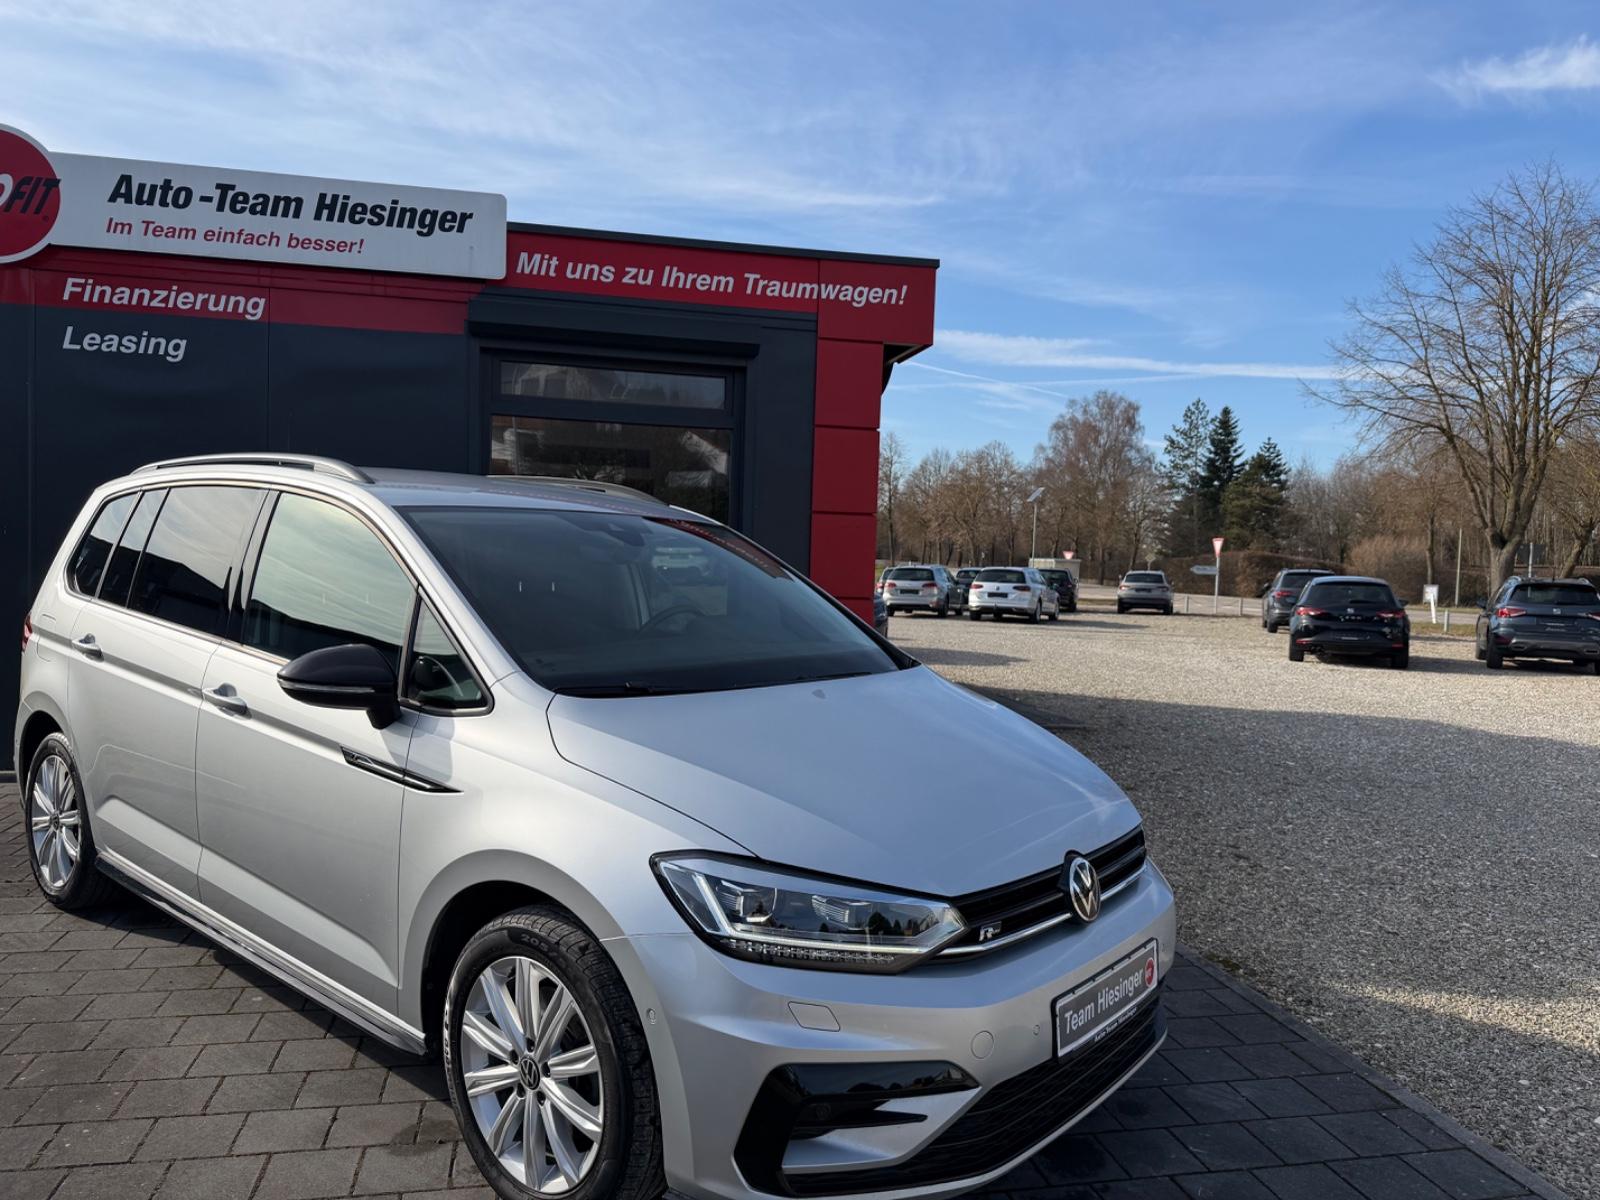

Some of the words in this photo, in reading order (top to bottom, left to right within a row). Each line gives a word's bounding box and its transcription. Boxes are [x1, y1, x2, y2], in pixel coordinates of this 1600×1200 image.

[105, 217, 133, 235] Im
[141, 220, 197, 241] Team
[203, 225, 281, 248] einfach
[287, 232, 365, 254] besser!
[313, 192, 474, 238] Hiesinger
[62, 277, 266, 321] Finanzierung
[516, 251, 559, 277] Mit
[565, 261, 616, 283] uns
[621, 267, 655, 286] zu
[661, 265, 735, 293] Ihrem
[743, 272, 908, 308] Traumwagen!
[62, 325, 188, 363] Leasing
[1064, 1002, 1095, 1034] Team
[1097, 968, 1144, 1014] Hiesinger
